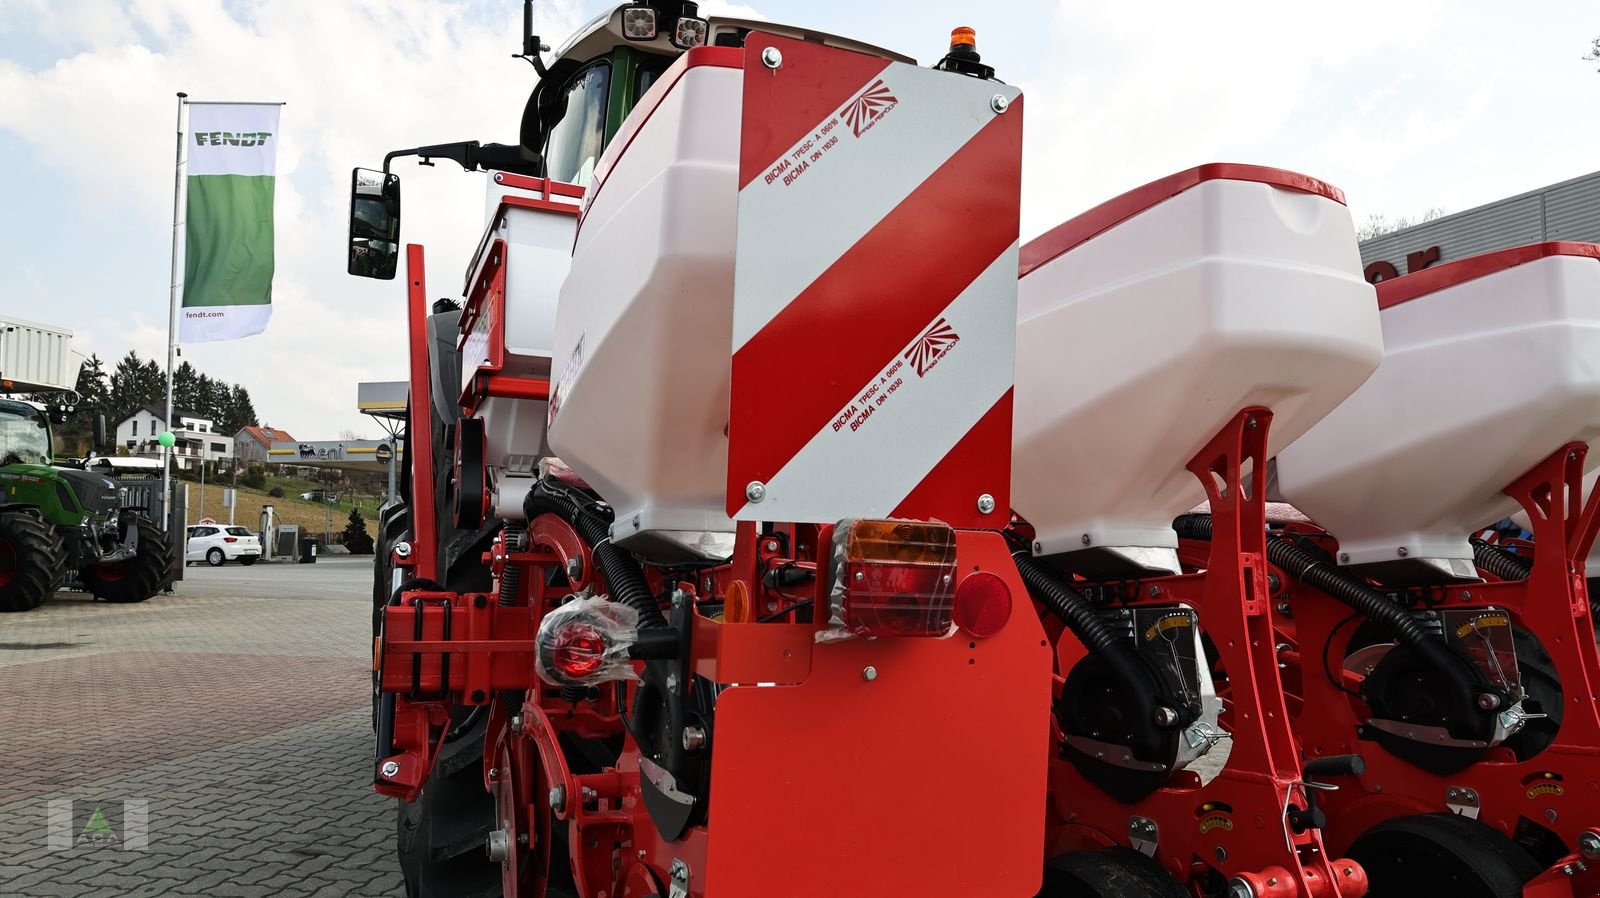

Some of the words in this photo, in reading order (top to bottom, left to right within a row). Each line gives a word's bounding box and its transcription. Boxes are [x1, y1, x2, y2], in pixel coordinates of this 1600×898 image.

[195, 131, 272, 147] FENDT
[764, 159, 792, 185] BICMA
[821, 118, 839, 136] 06016
[783, 160, 810, 186] BICMA
[810, 150, 823, 163] DIN
[822, 136, 839, 153] 11030
[185, 310, 224, 319] fendt.com
[832, 405, 858, 432] BICMA
[886, 360, 903, 378] 06016
[850, 405, 876, 432] BICMA
[876, 393, 888, 407] DIN
[887, 378, 903, 395] 11030
[318, 443, 343, 460] eni
